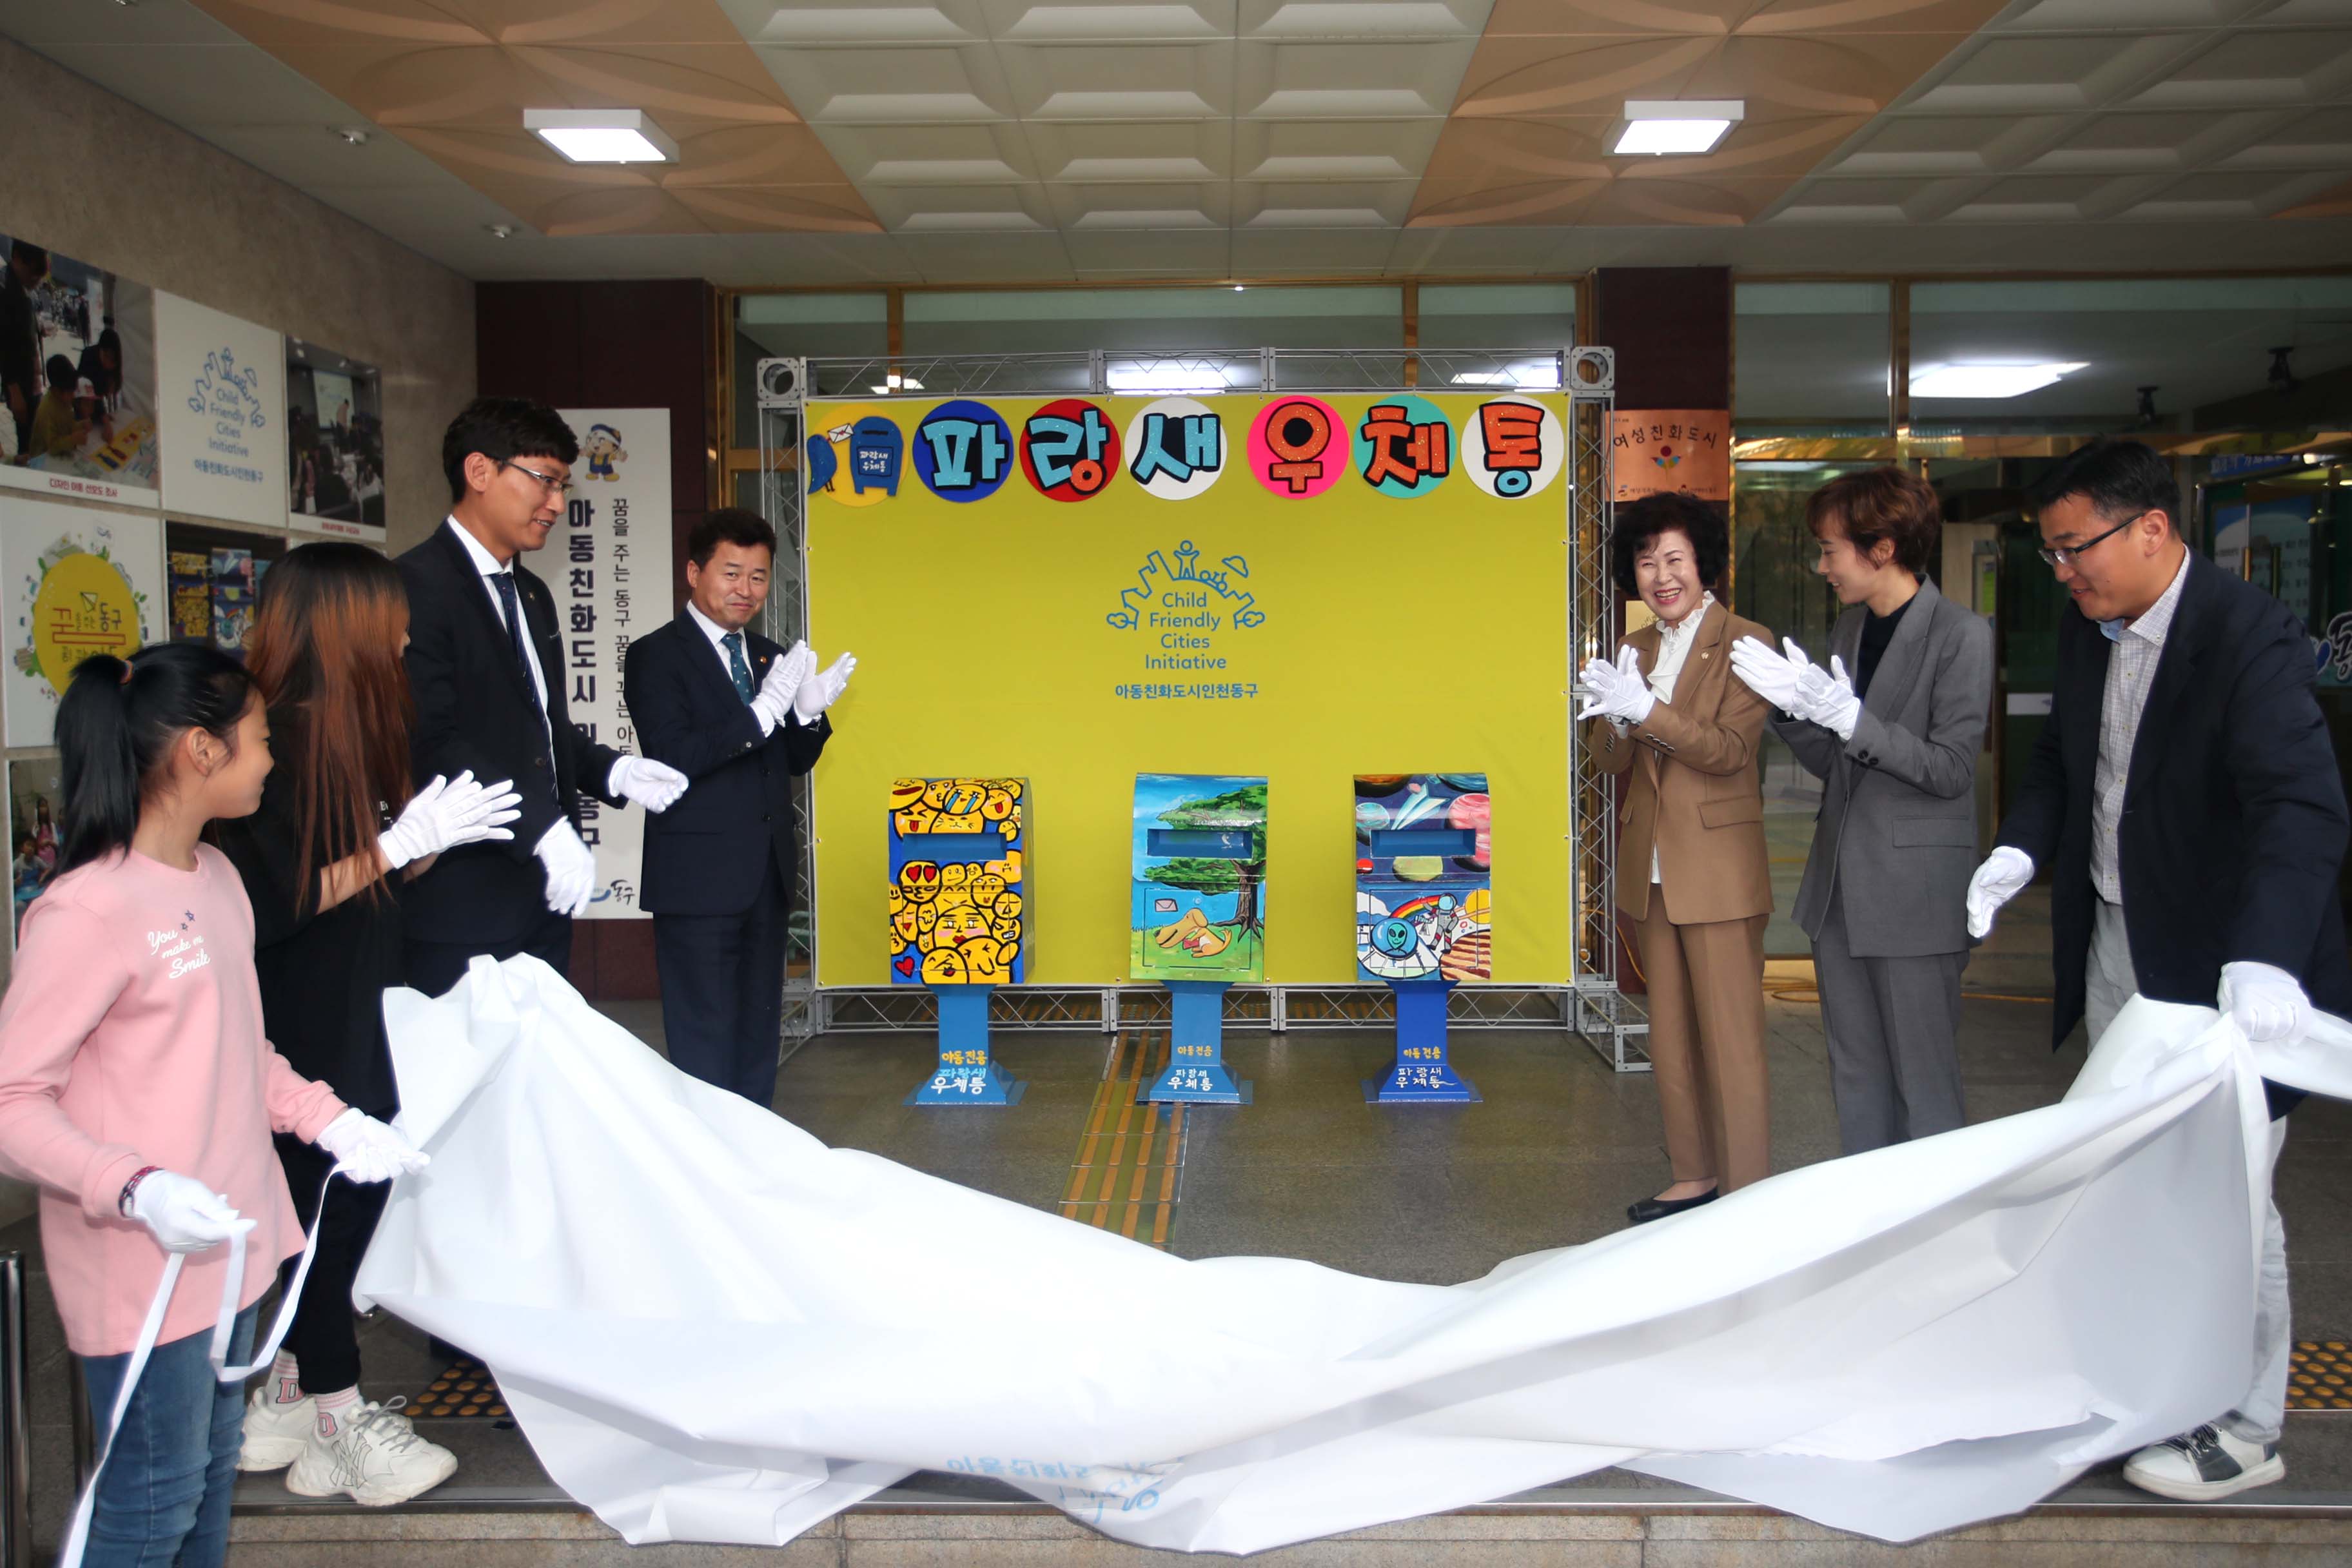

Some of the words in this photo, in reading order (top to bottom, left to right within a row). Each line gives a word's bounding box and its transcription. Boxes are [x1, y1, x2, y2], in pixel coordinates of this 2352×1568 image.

[216, 387, 239, 406] Child
[210, 402, 246, 426] Friendly
[216, 421, 241, 439] Cities
[1612, 424, 1717, 449] 여성친화도시
[208, 436, 250, 457] Initiative
[859, 450, 888, 460] 파랑새
[921, 406, 1221, 495] 파랑새
[1265, 400, 1545, 498] 우체통
[863, 460, 886, 473] 우체통
[612, 498, 630, 537] 꿈을
[613, 544, 631, 582] 주는
[569, 498, 598, 703] 아동친화도시
[614, 589, 631, 628] 동구
[1162, 592, 1207, 608] Child
[1150, 611, 1221, 632] Friendly
[1161, 632, 1210, 649] Cities
[1146, 653, 1227, 670] Initiative
[1115, 683, 1259, 700] 아동친화도시인천동구
[611, 879, 636, 905] 동구
[148, 930, 179, 956] You
[168, 948, 211, 979] Smile
[937, 1067, 986, 1080] 파랑새
[1398, 1066, 1442, 1077] 파랑새
[1167, 1076, 1213, 1091] 우체통
[1395, 1076, 1448, 1089] 우체통
